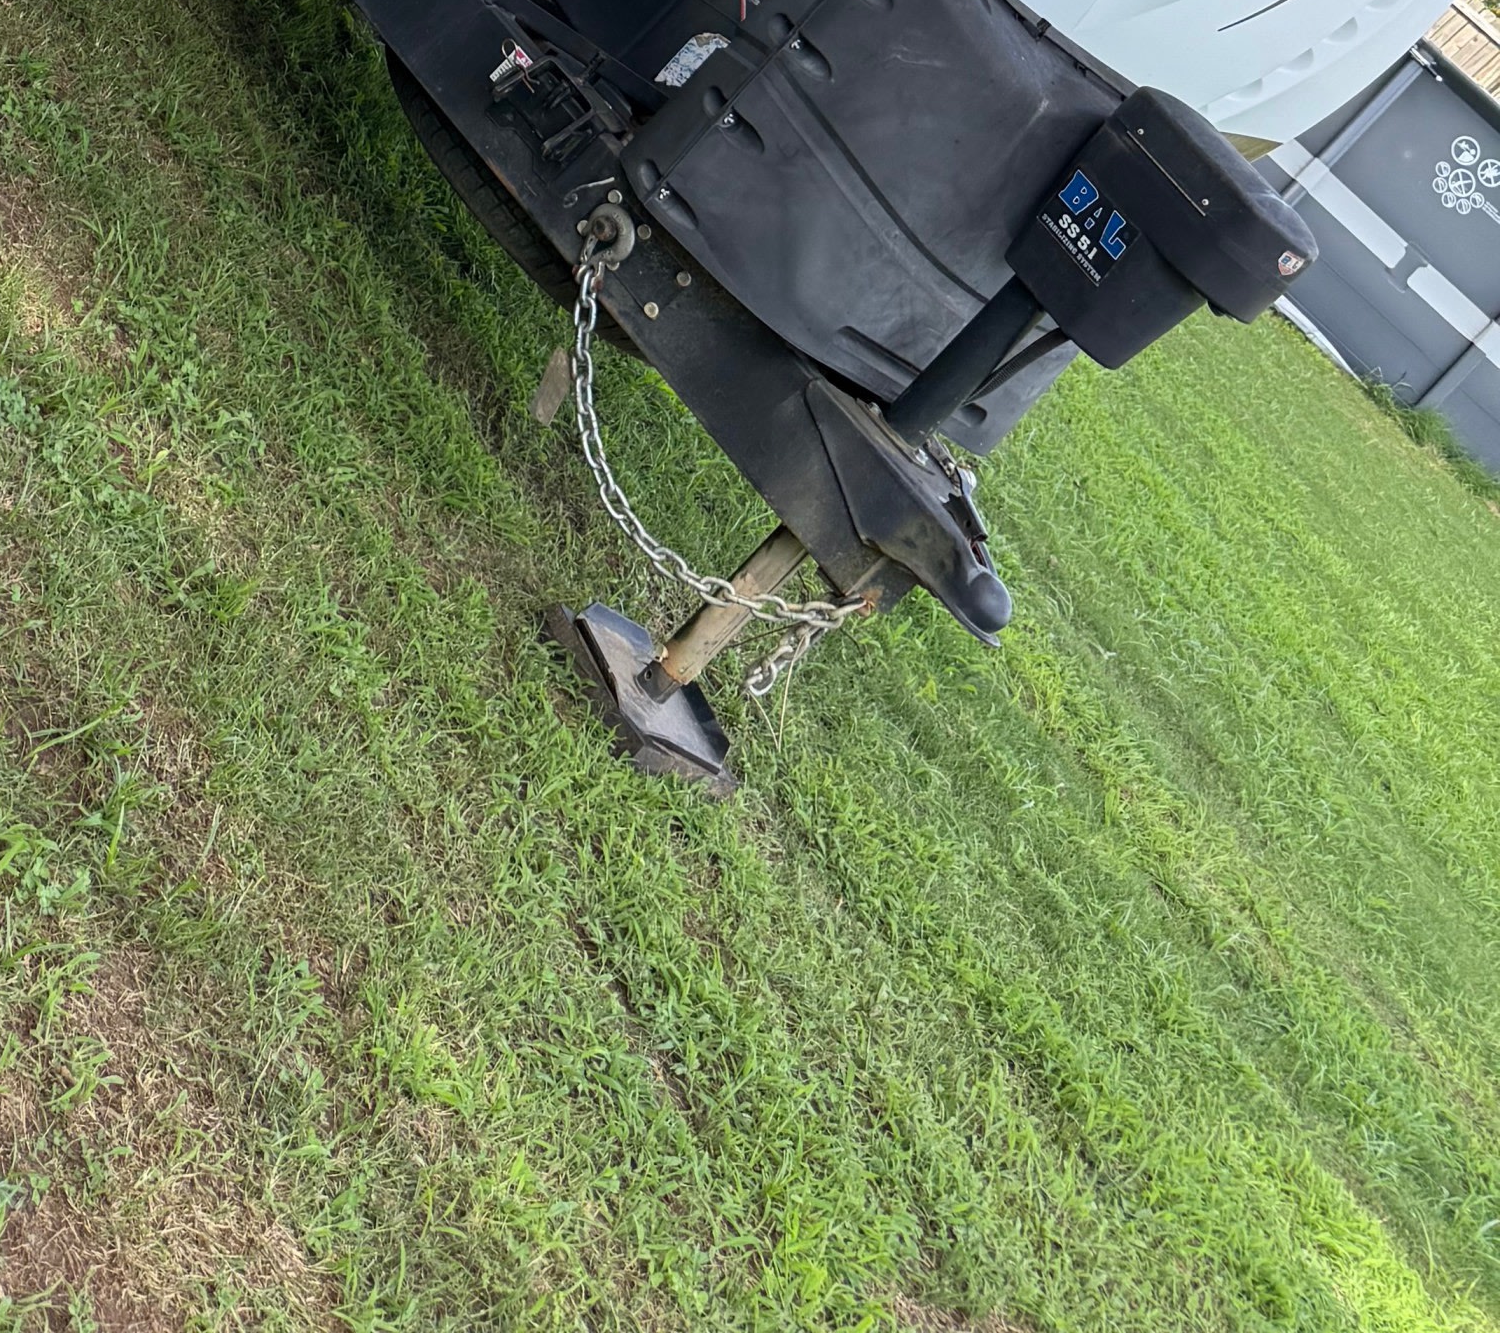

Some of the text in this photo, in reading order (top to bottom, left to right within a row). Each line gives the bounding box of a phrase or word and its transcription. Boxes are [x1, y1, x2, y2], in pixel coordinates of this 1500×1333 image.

[1041, 213, 1101, 282] STABILIZING SYSTEM
[1058, 213, 1081, 238] SS
